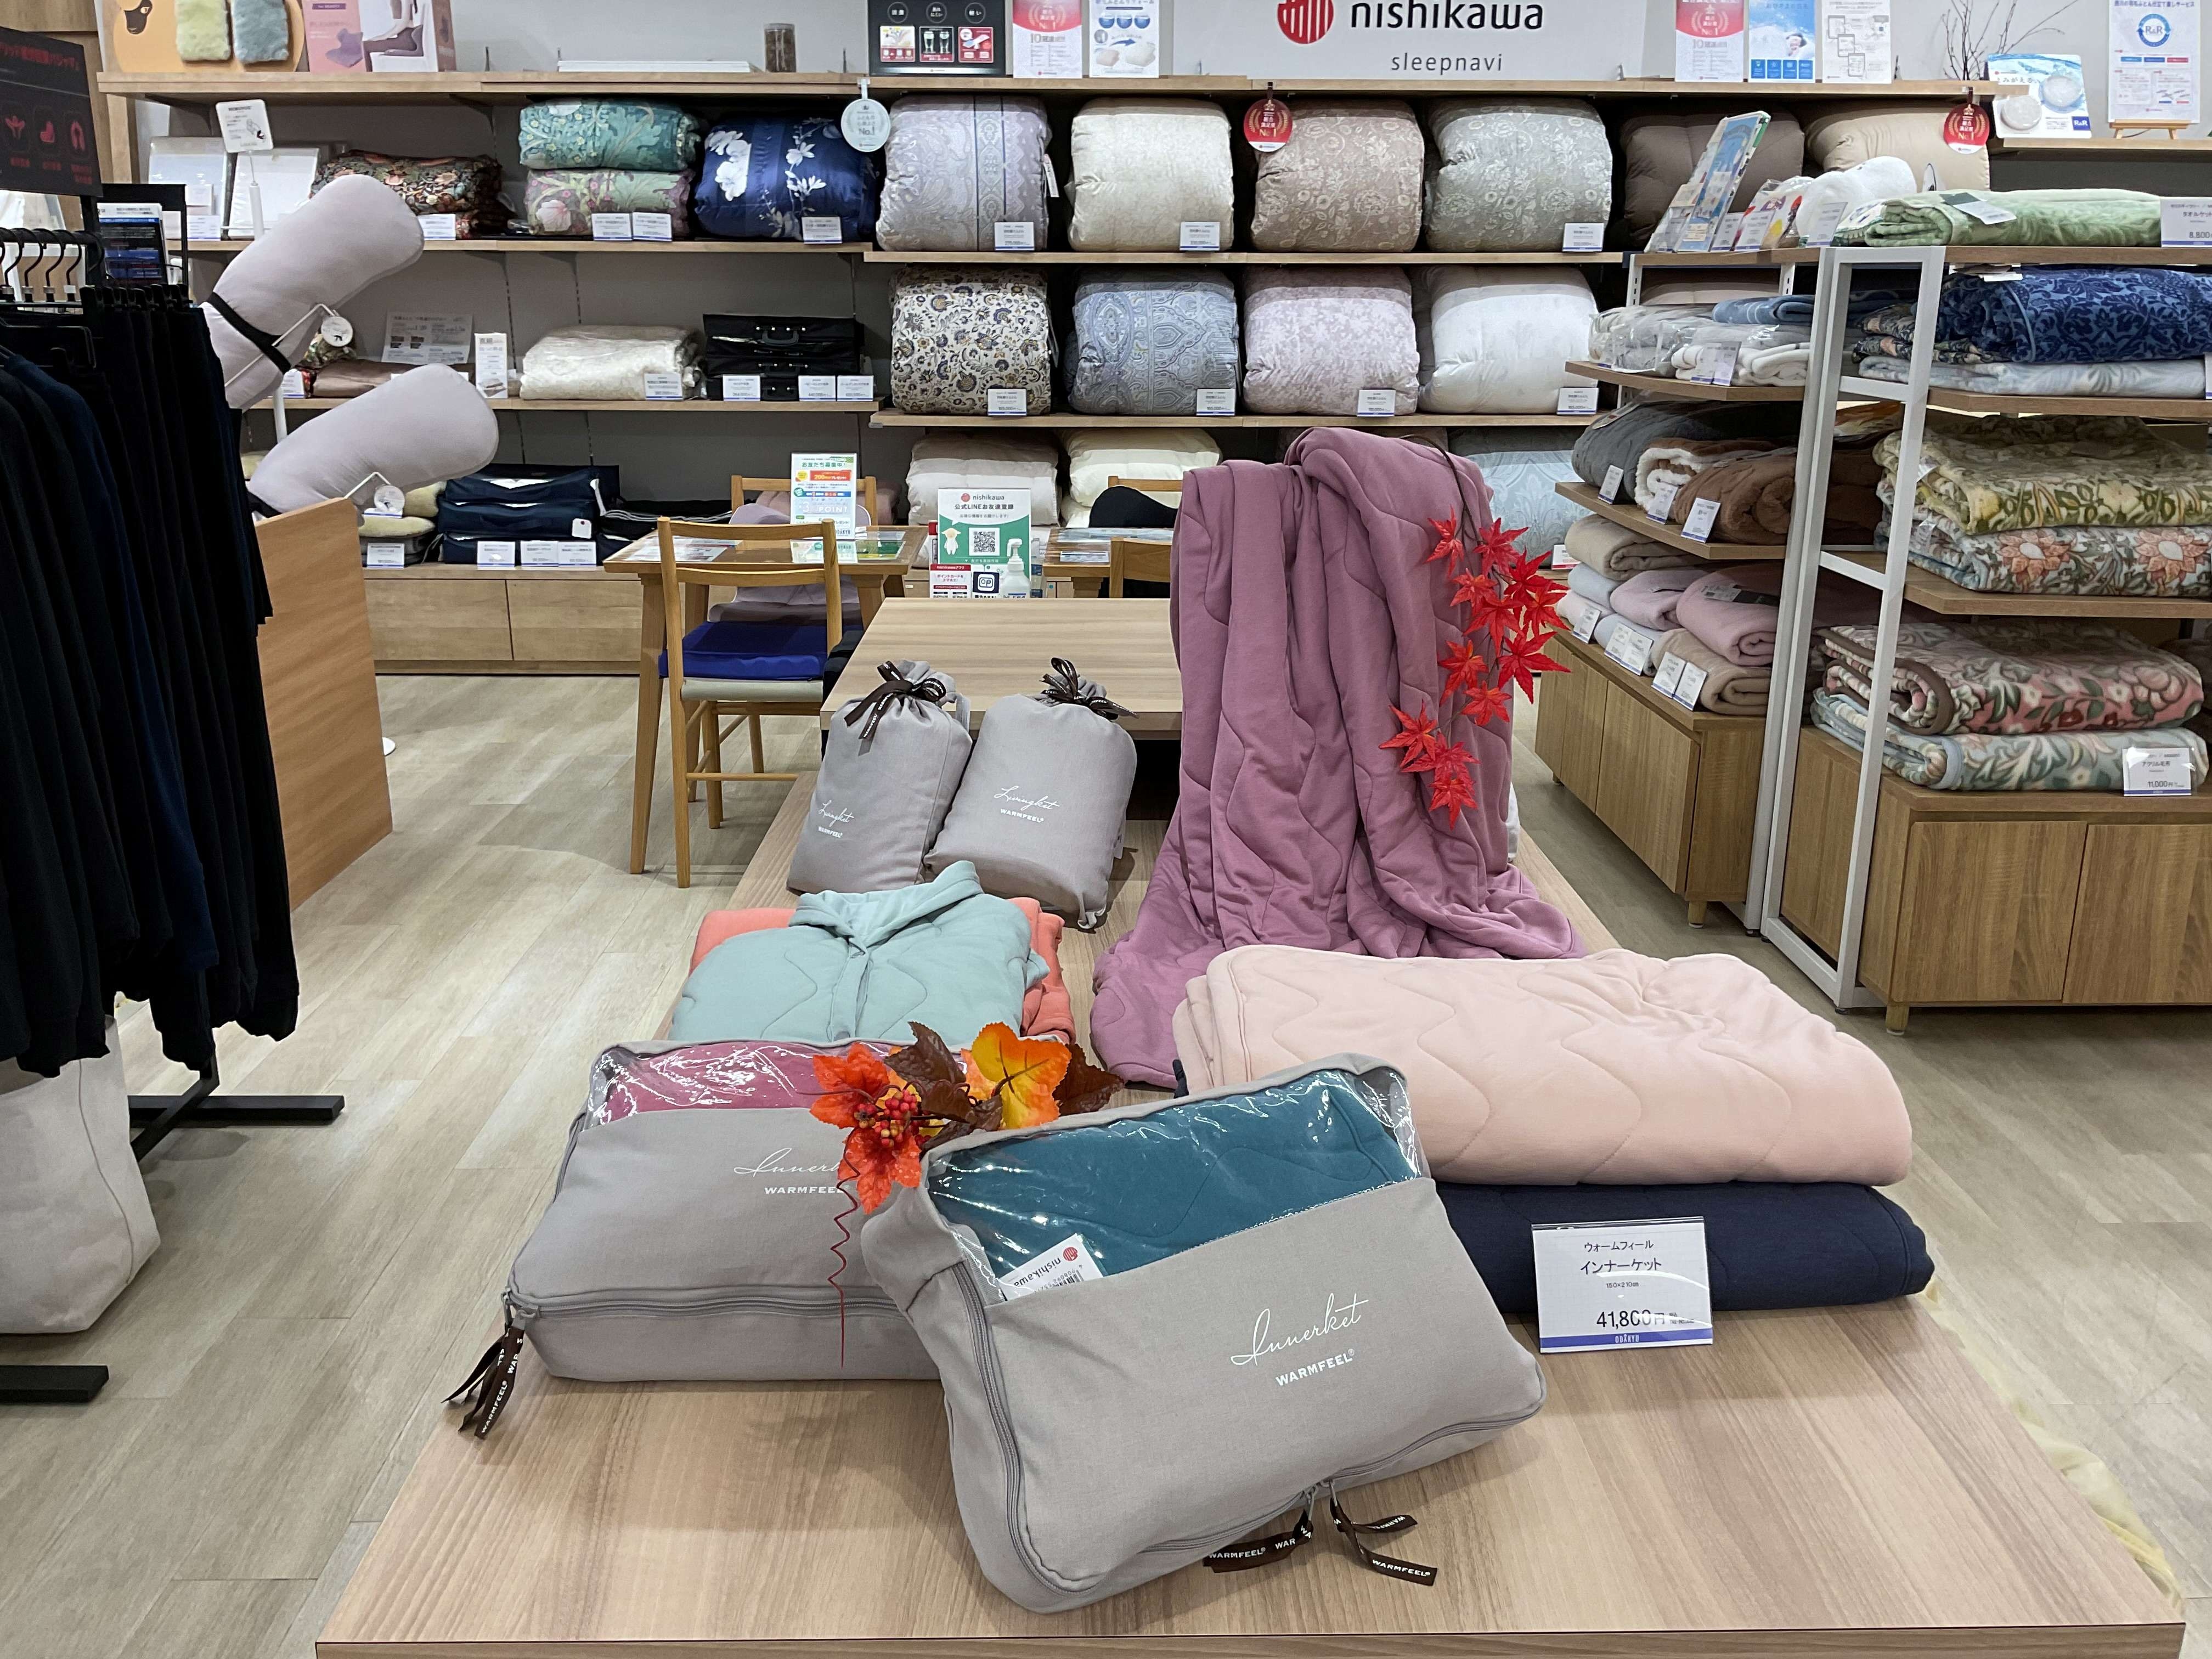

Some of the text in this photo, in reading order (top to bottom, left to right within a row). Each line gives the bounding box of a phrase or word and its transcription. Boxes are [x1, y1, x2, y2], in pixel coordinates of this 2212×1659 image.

[1351, 0, 1543, 30] nishikawa
[1391, 53, 1502, 75] sleepnavi
[1584, 1240, 1654, 1252] ウォームフィール
[1014, 1257, 1062, 1287] nishikawa
[1580, 1257, 1662, 1275] インナーケット
